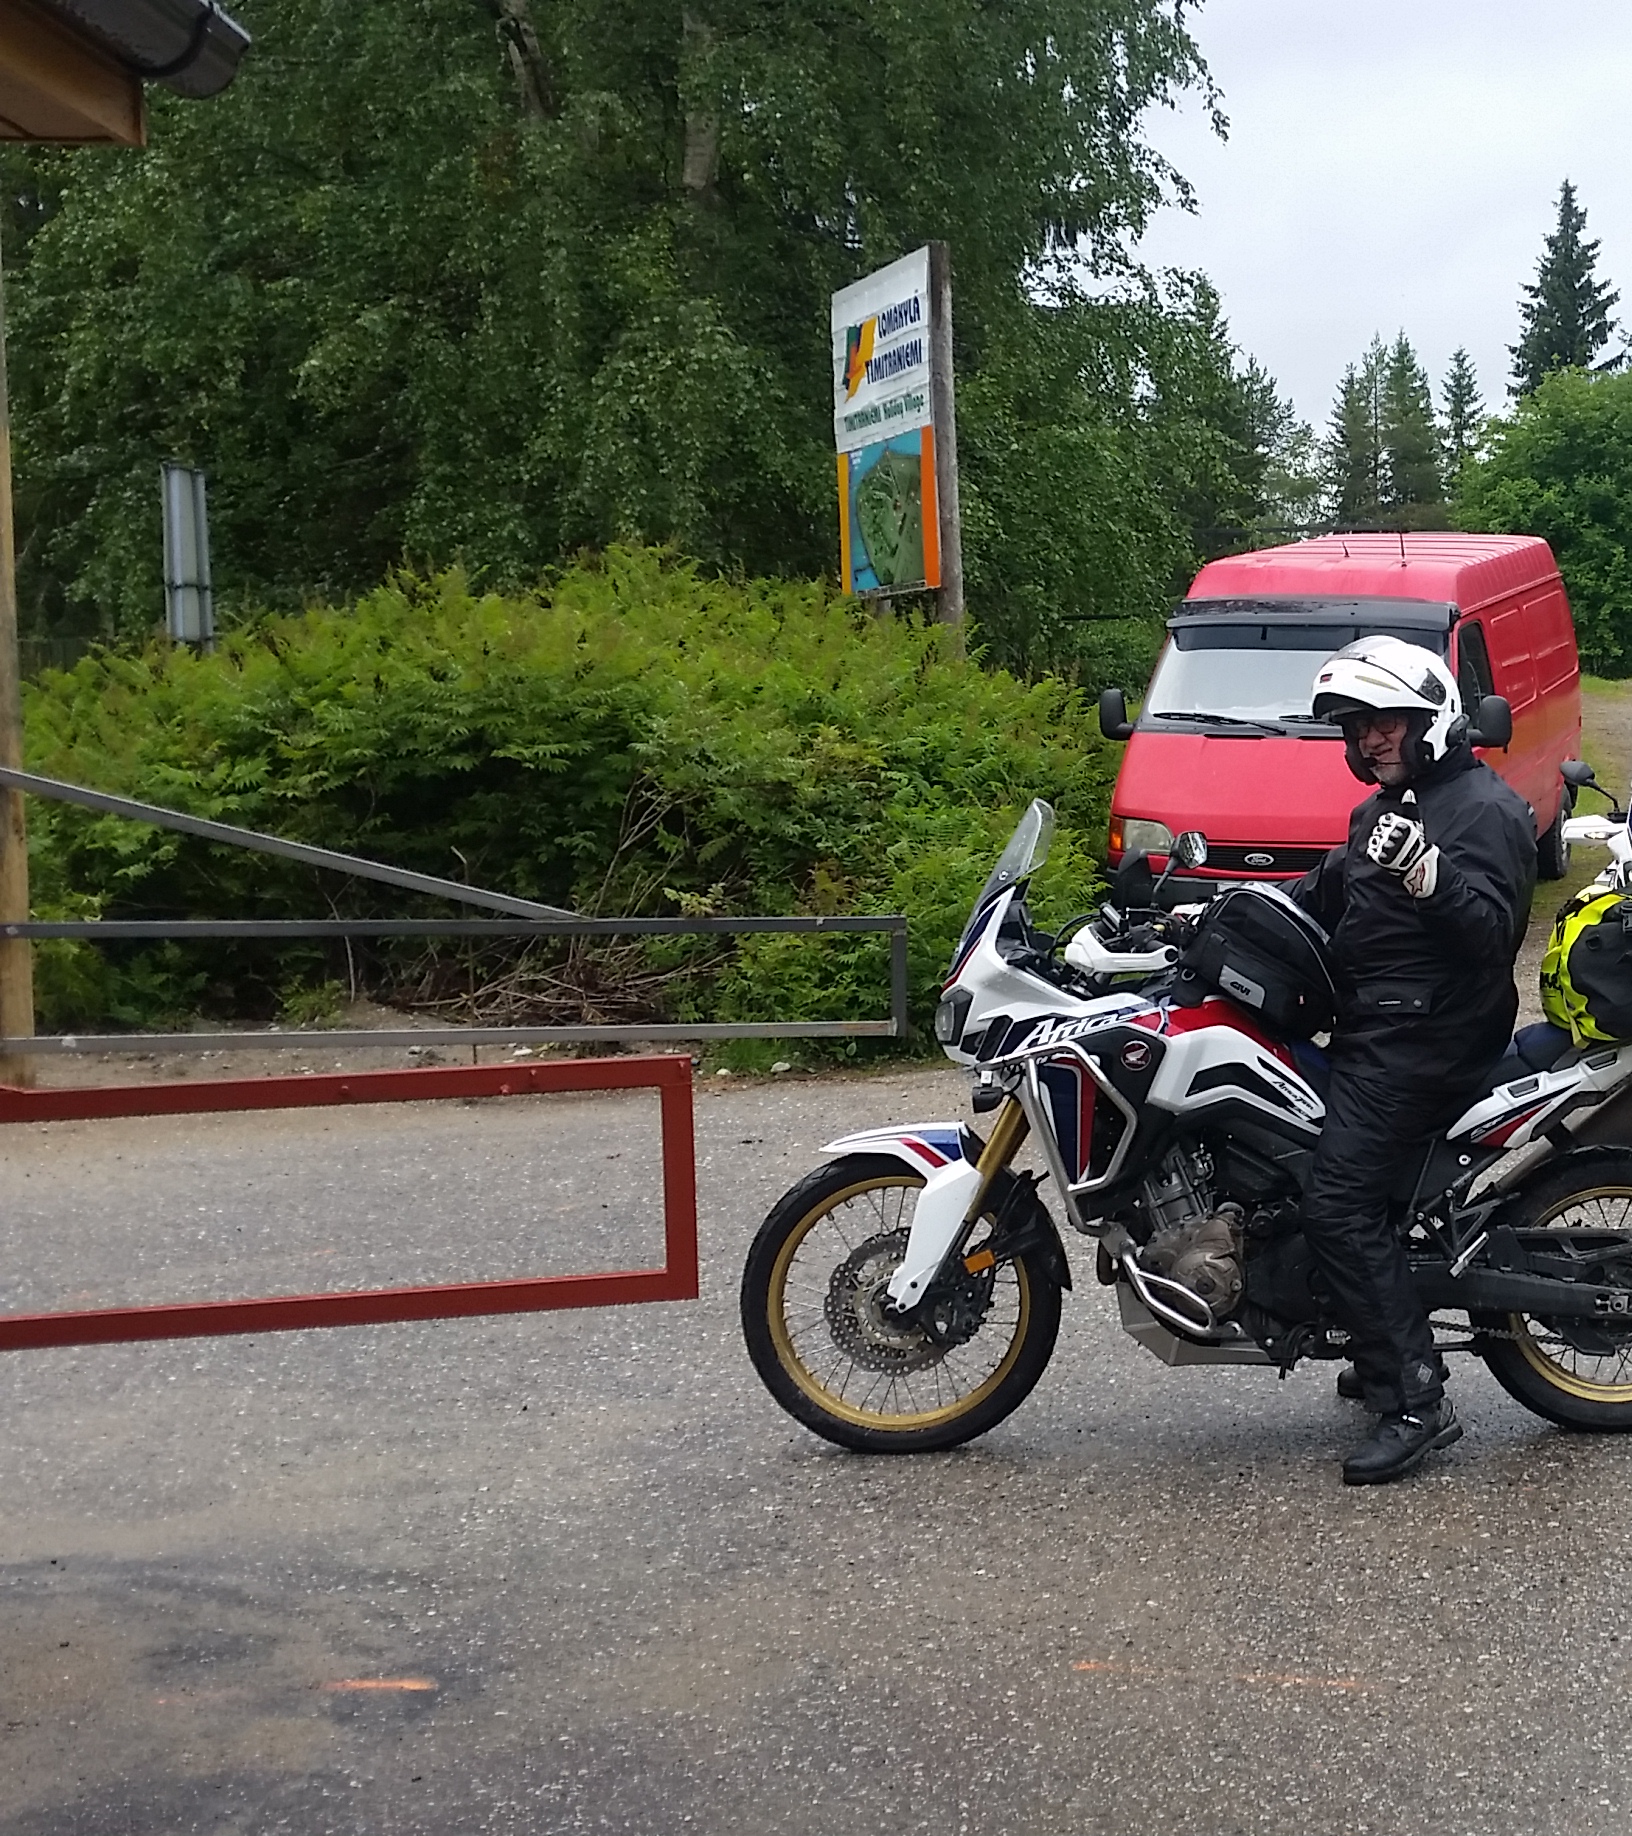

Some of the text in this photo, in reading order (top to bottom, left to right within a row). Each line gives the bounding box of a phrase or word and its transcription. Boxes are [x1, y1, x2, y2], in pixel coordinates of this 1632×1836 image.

[864, 338, 923, 385] TIMITRANIEMI
[1229, 980, 1252, 996] GIVI
[1012, 1012, 1122, 1055] Africa
